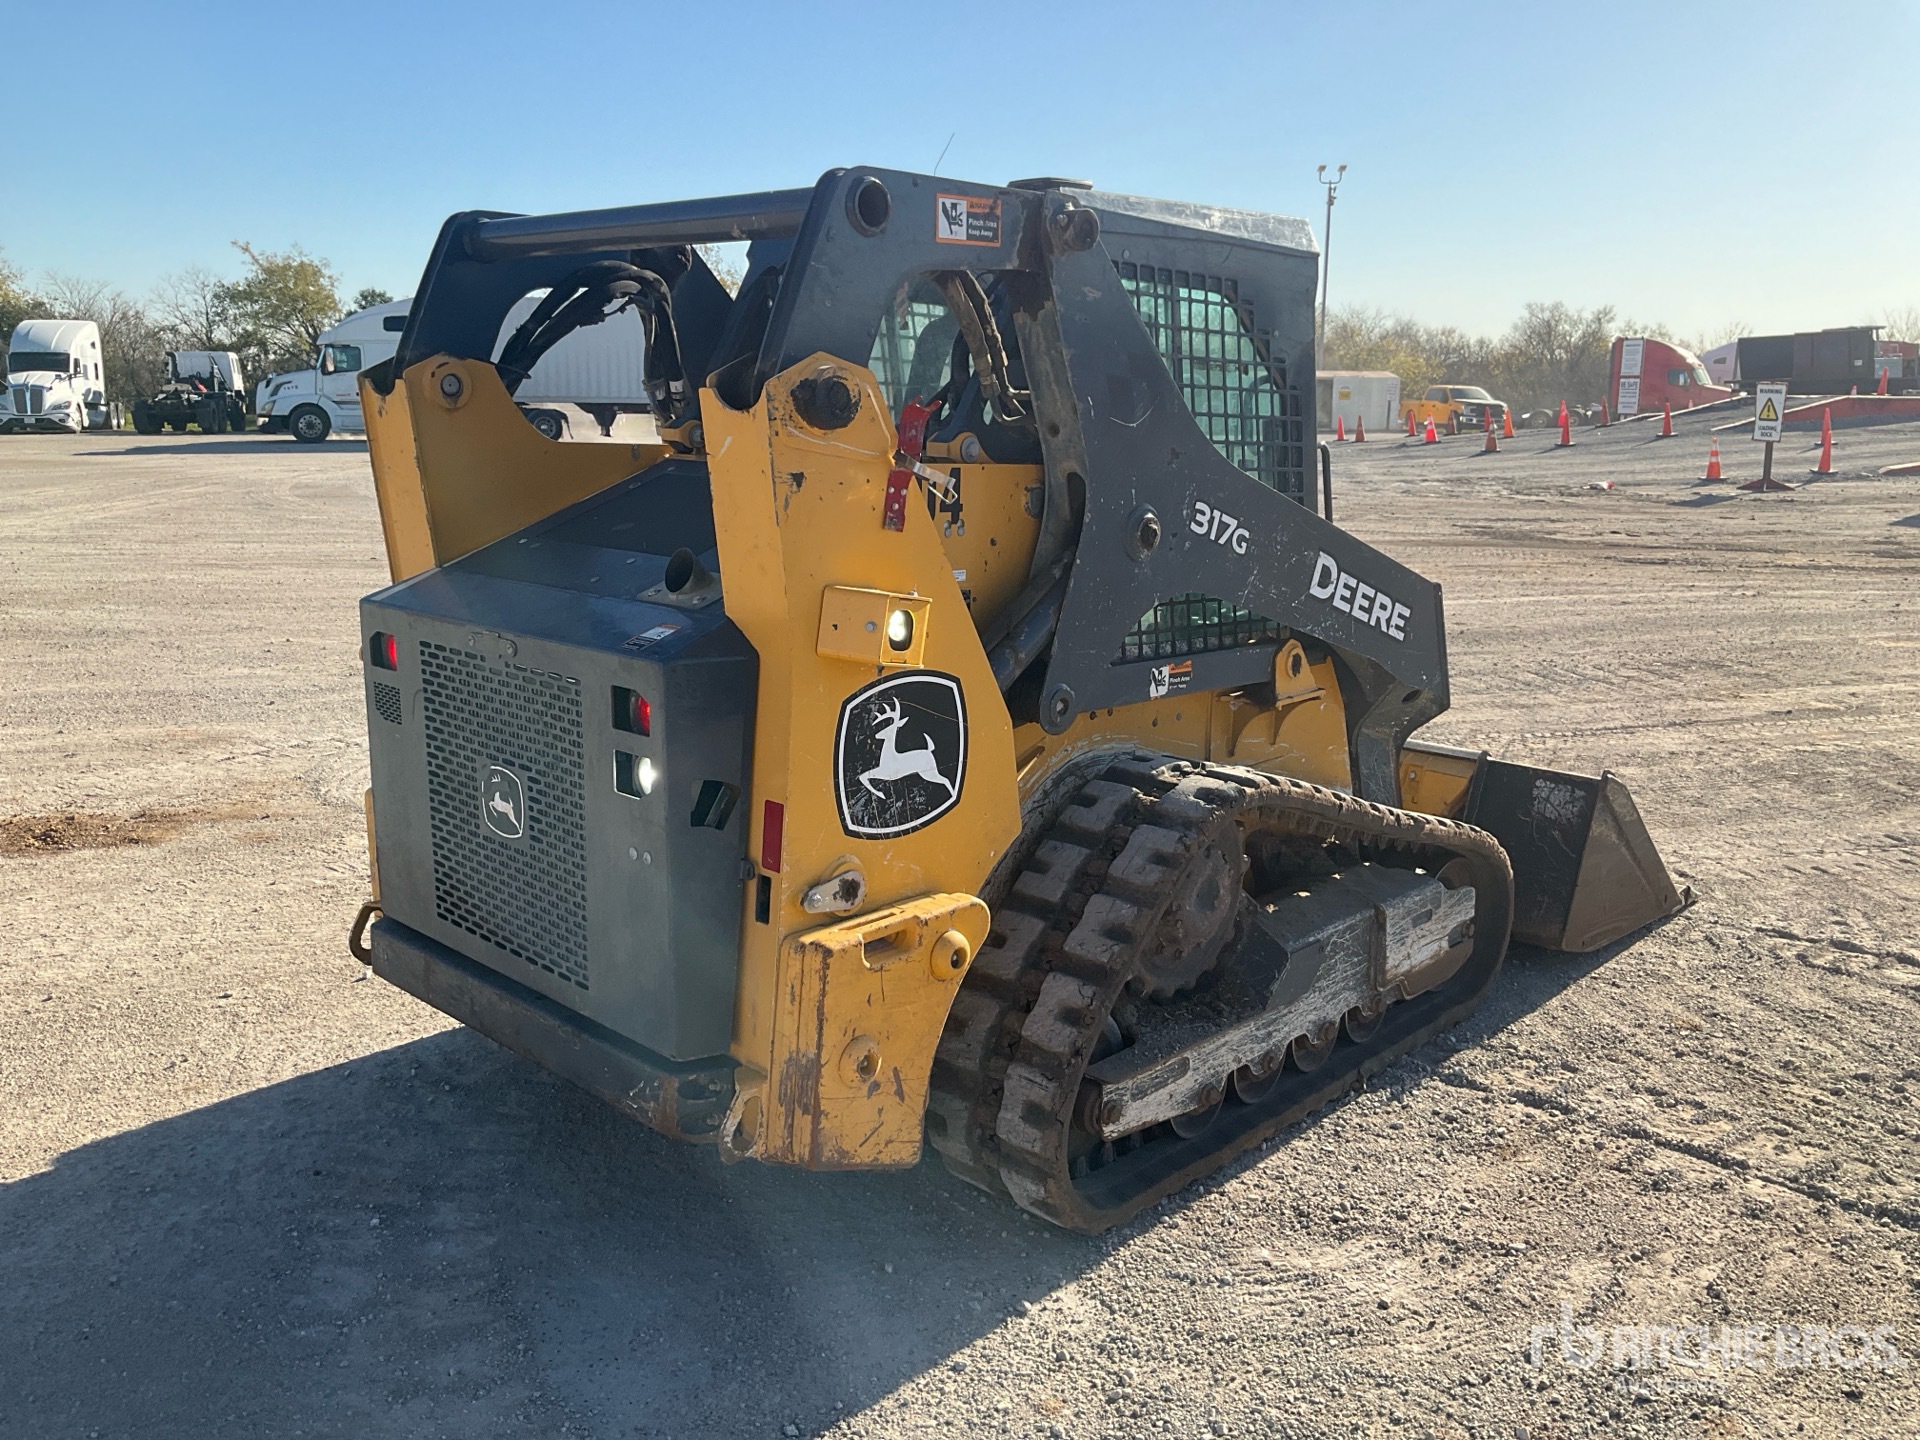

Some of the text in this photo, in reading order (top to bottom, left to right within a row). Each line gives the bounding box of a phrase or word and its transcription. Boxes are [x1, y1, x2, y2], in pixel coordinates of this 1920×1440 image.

[968, 218, 997, 228] Pinch Area
[968, 228, 993, 238] Keep Away
[1627, 381, 1639, 389] SAFE
[1189, 501, 1250, 555] 317G
[1309, 550, 1411, 642] DEERE
